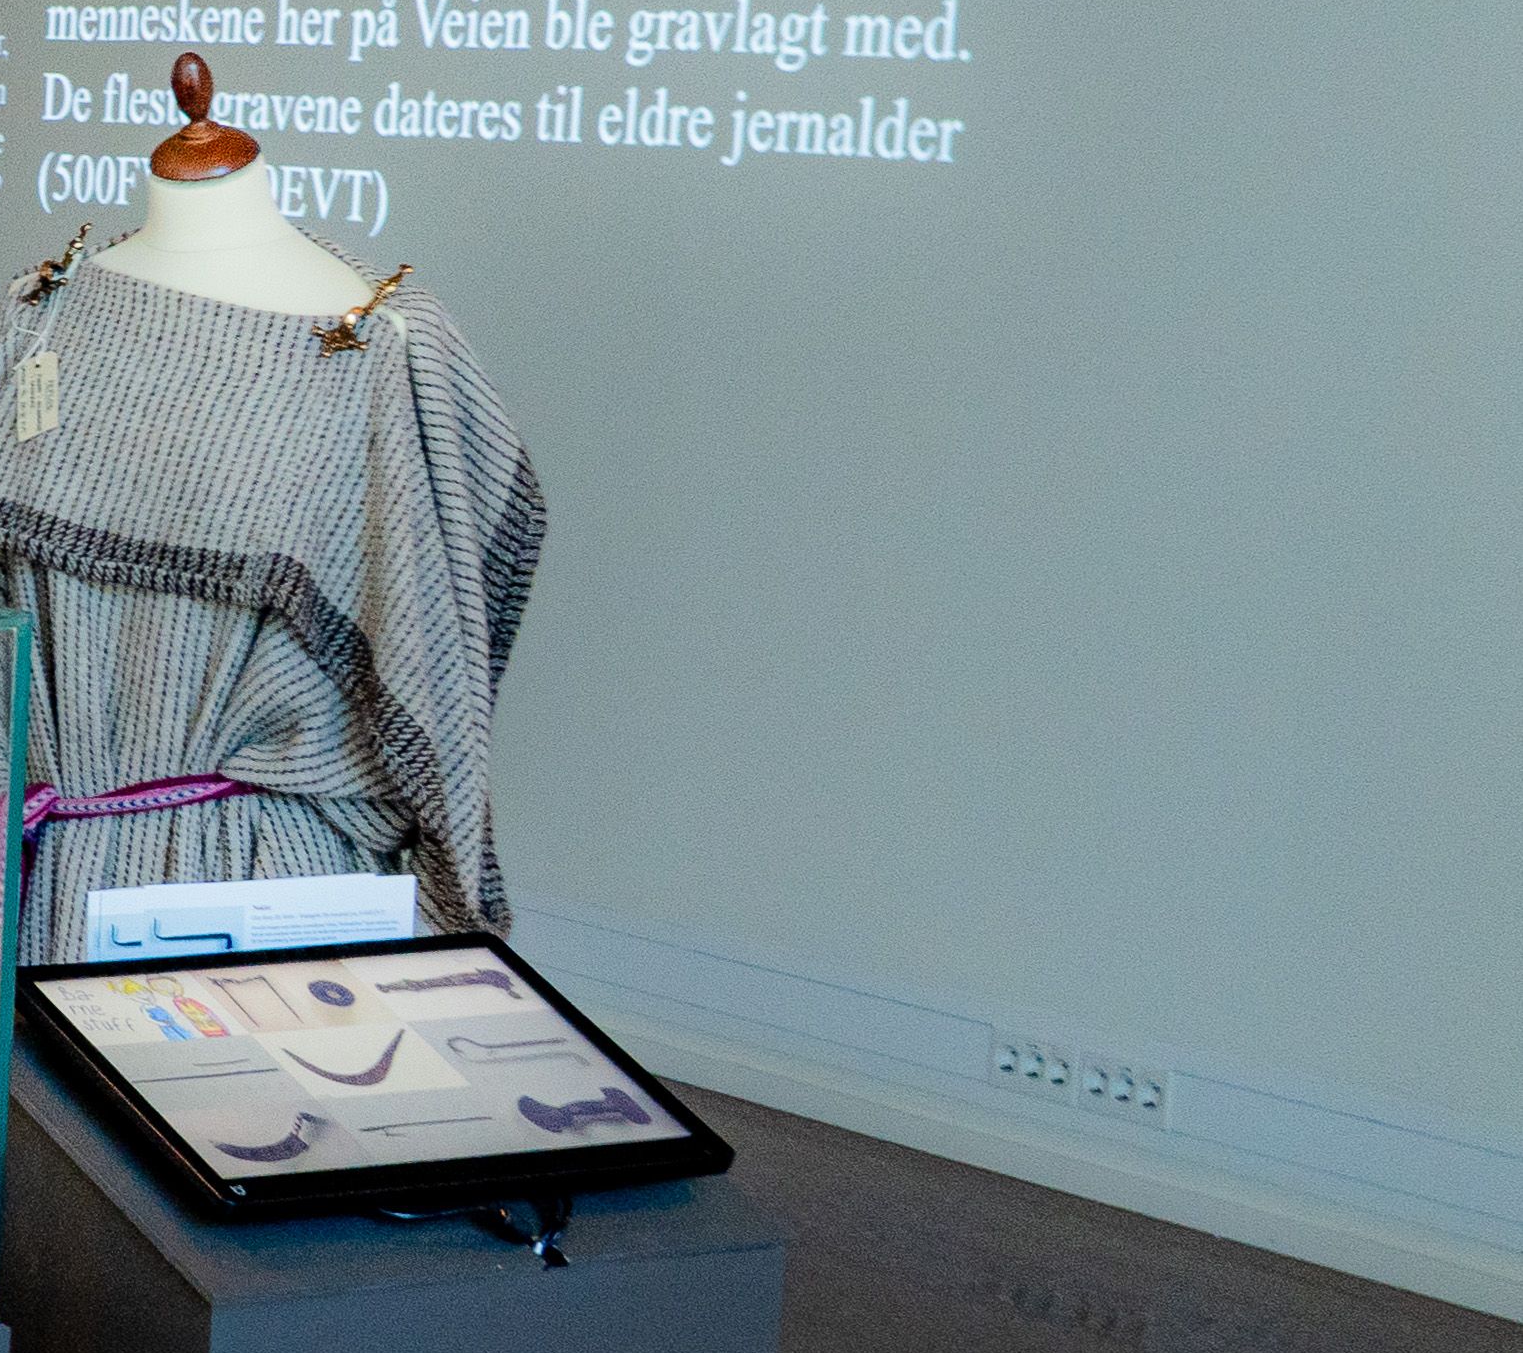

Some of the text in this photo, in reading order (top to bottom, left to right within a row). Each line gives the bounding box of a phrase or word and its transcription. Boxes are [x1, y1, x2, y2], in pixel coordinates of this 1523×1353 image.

[41, 73, 93, 123] De
[211, 90, 361, 134] gravene
[373, 82, 521, 141] dateres
[536, 85, 582, 142] til
[598, 87, 714, 148] eldre
[721, 91, 964, 168] jernalder
